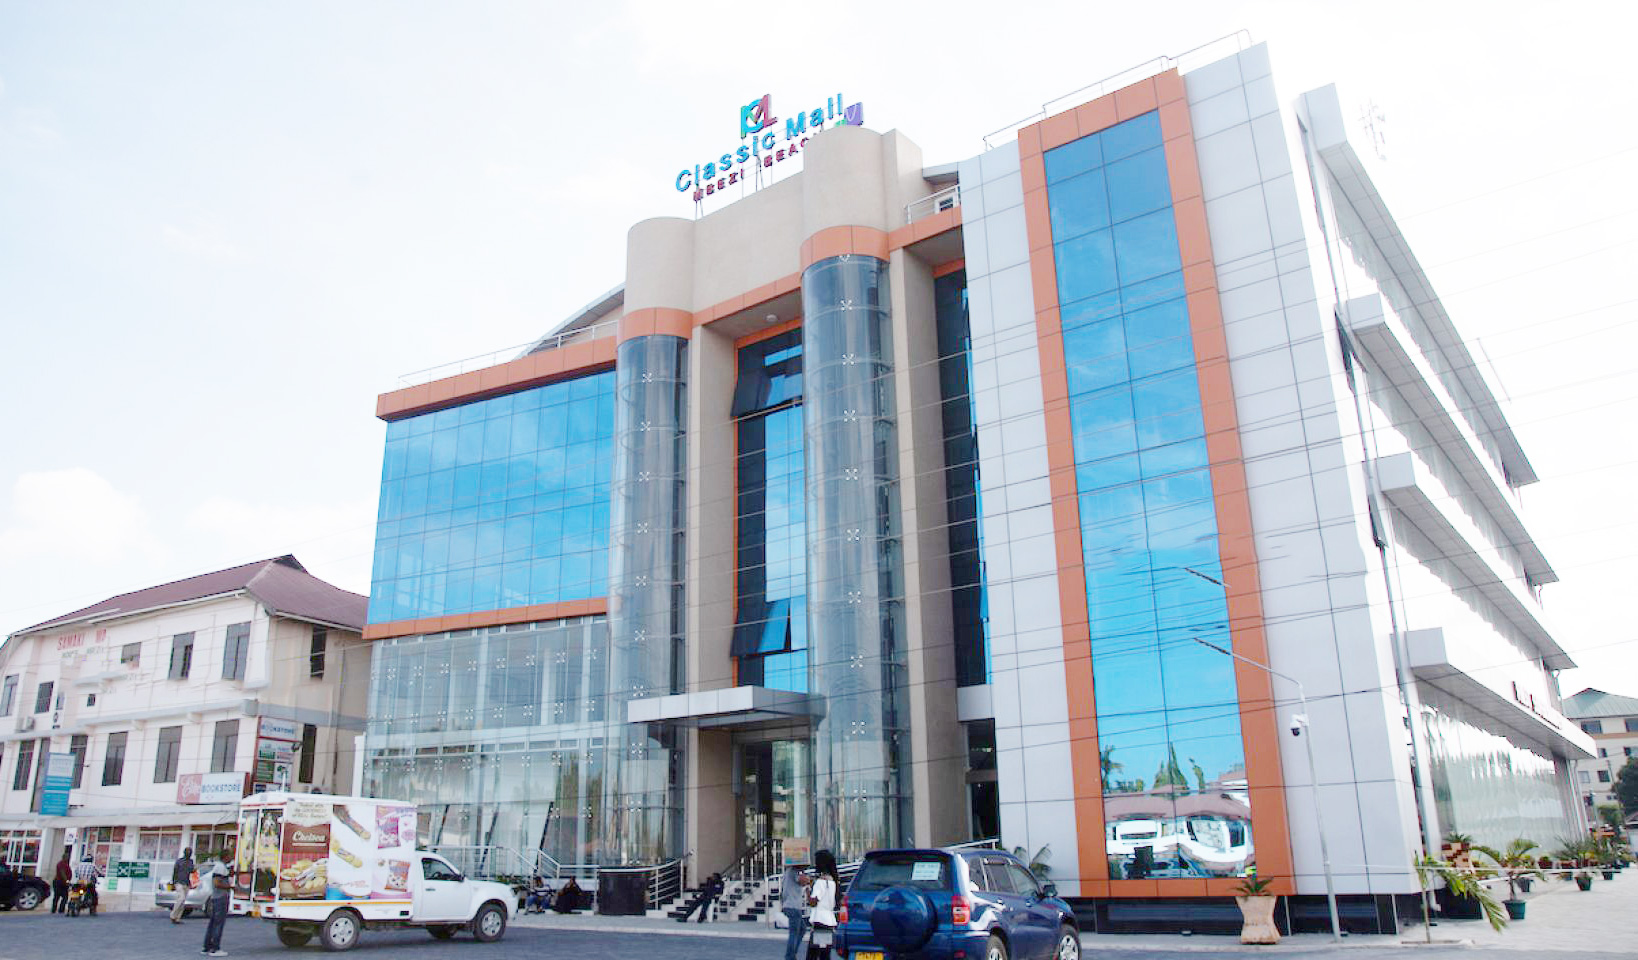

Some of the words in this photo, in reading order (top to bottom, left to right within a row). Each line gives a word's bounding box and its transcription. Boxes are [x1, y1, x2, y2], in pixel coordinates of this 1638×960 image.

[676, 133, 776, 192] Classic
[786, 93, 843, 140] Mall
[764, 136, 812, 168] BEAC
[202, 783, 241, 793] BOOKSTORE
